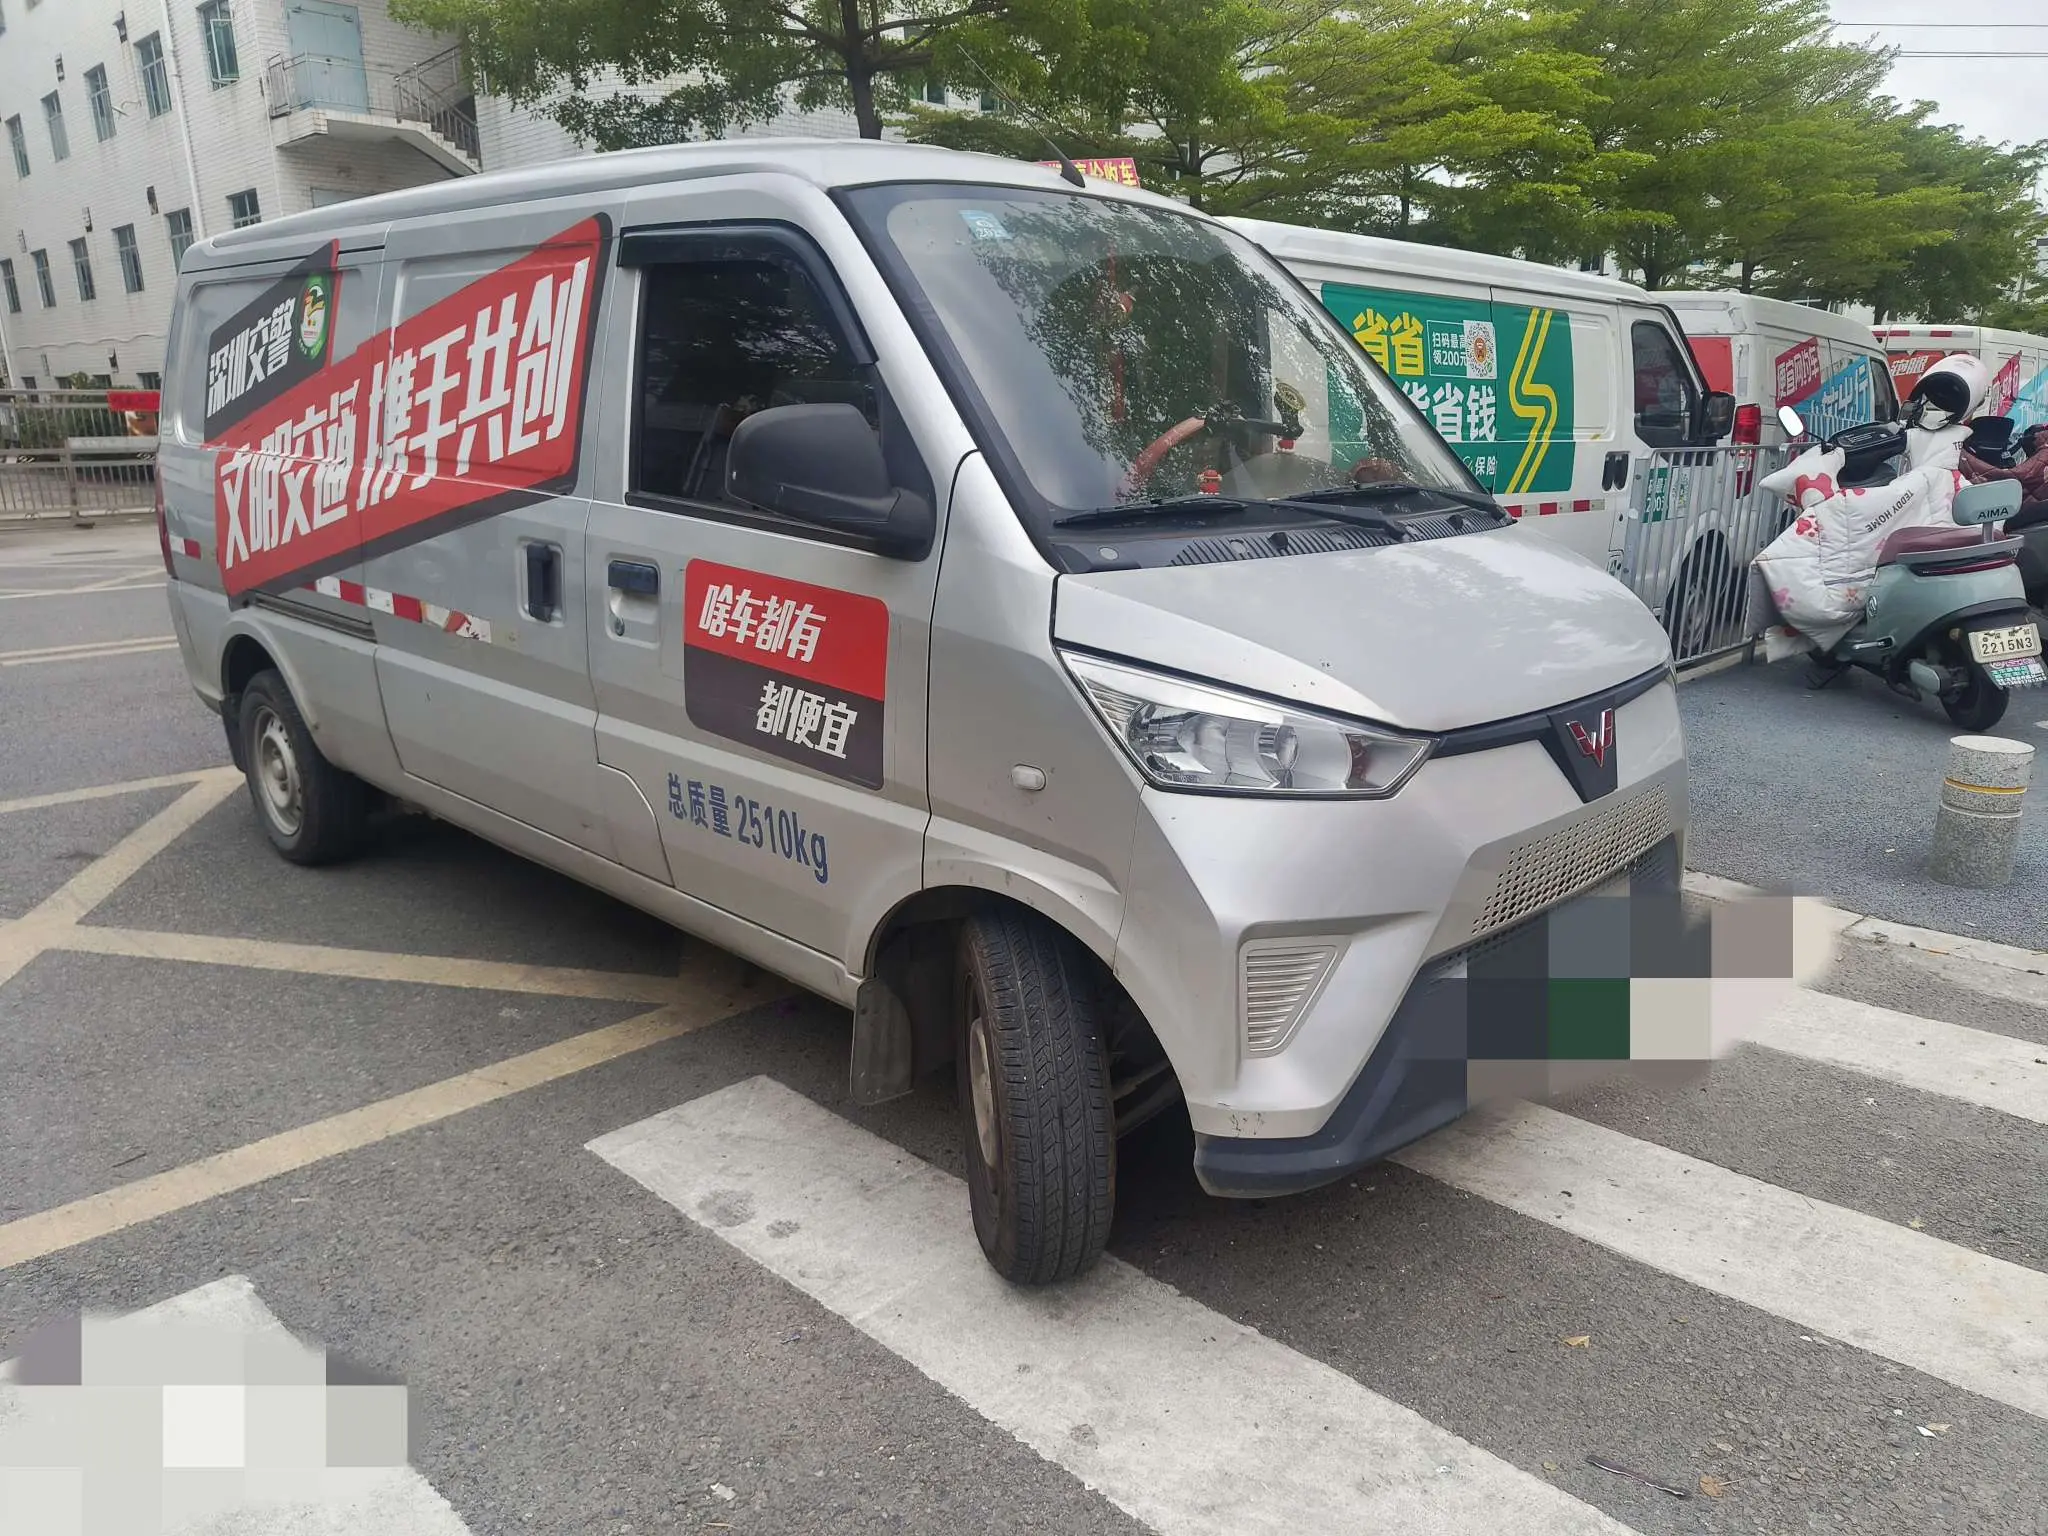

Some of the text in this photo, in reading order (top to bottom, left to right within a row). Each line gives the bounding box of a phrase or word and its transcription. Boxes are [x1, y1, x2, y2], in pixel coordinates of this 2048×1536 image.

[207, 296, 297, 419] 深圳交警
[1353, 308, 1425, 376] 省省
[1864, 489, 1914, 533] TEDDY HOME
[1977, 507, 2009, 520] AIMA
[698, 584, 827, 662] 啥车都有
[1982, 637, 2033, 655] 2215N3
[756, 680, 858, 759] 都便宜
